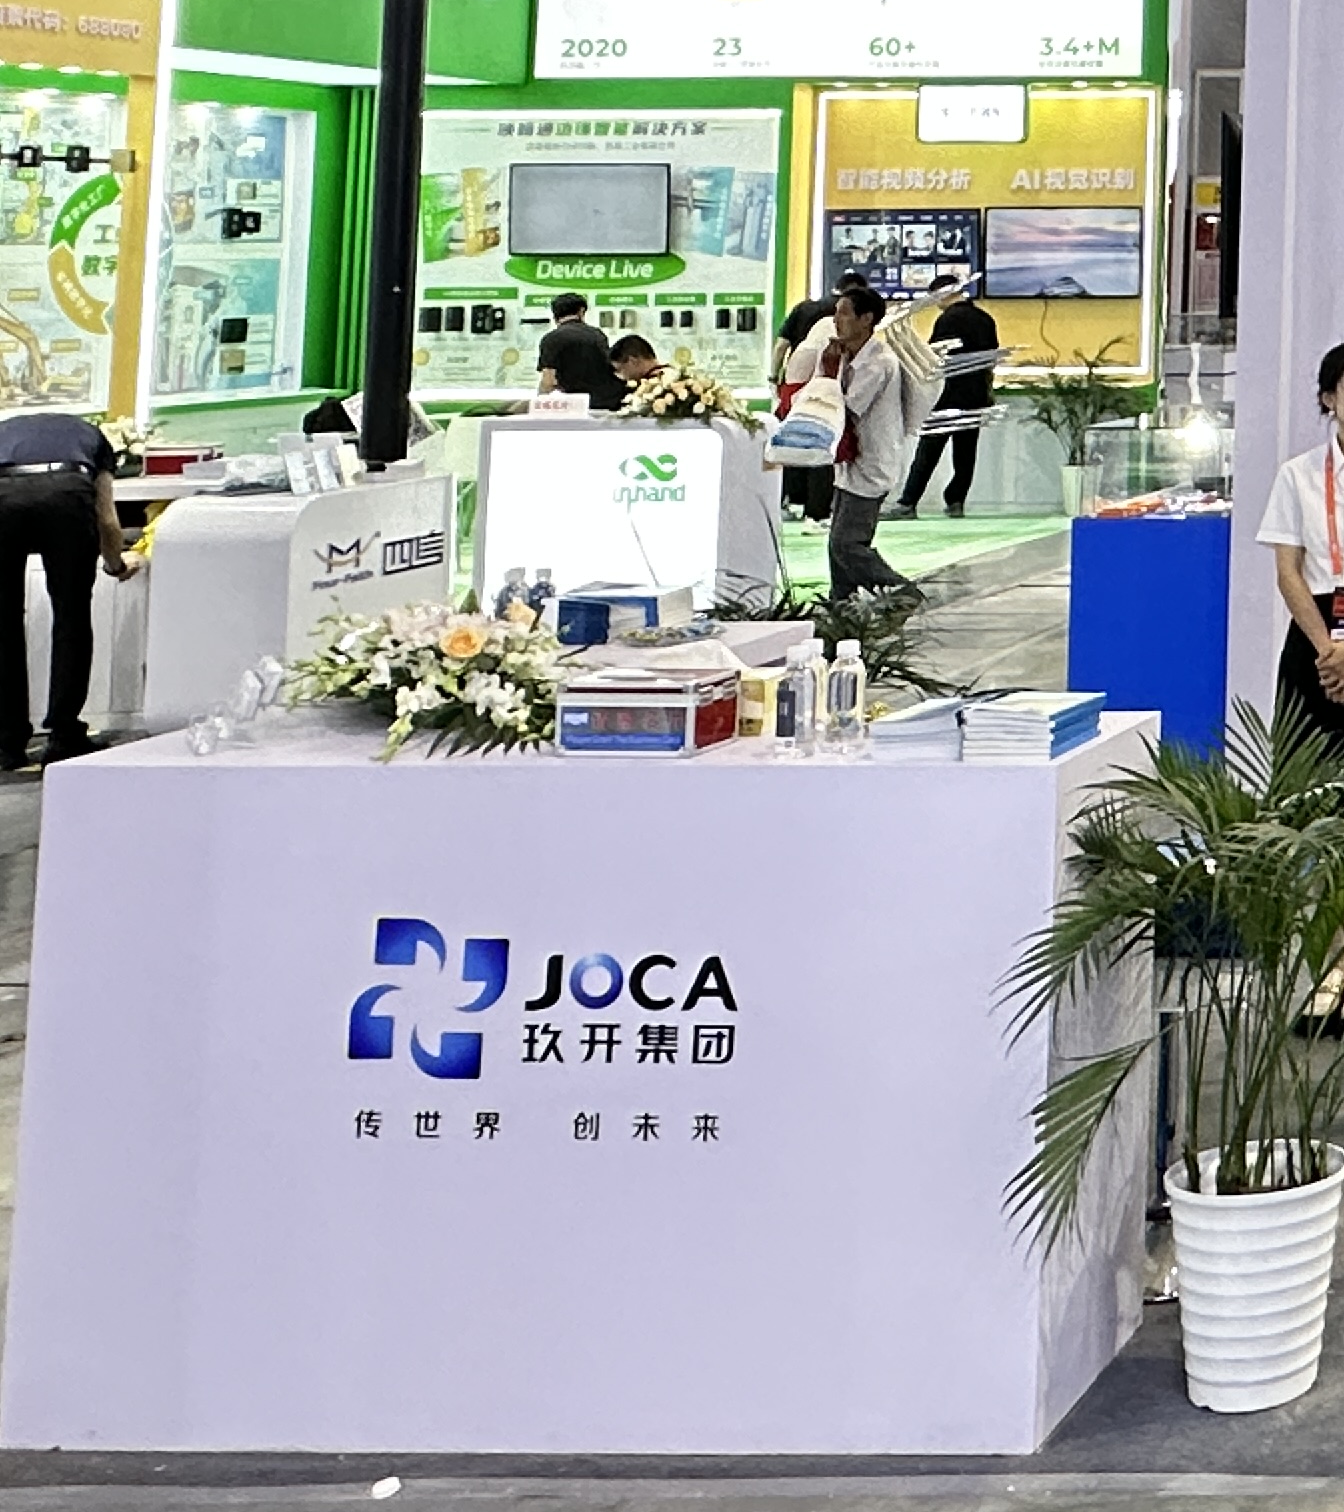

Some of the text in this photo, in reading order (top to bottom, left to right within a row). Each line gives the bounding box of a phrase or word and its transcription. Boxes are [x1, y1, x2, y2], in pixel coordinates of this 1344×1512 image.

[560, 37, 628, 58] 2020
[712, 37, 743, 57] 23
[868, 36, 917, 57] 60+
[1038, 36, 1121, 57] 3.4+M
[1010, 168, 1041, 190] AI
[536, 259, 654, 279] Device Live
[524, 952, 738, 1012] JOCA
[521, 1022, 736, 1064] 玖开集团
[354, 1108, 720, 1142] 传世界 创未来
